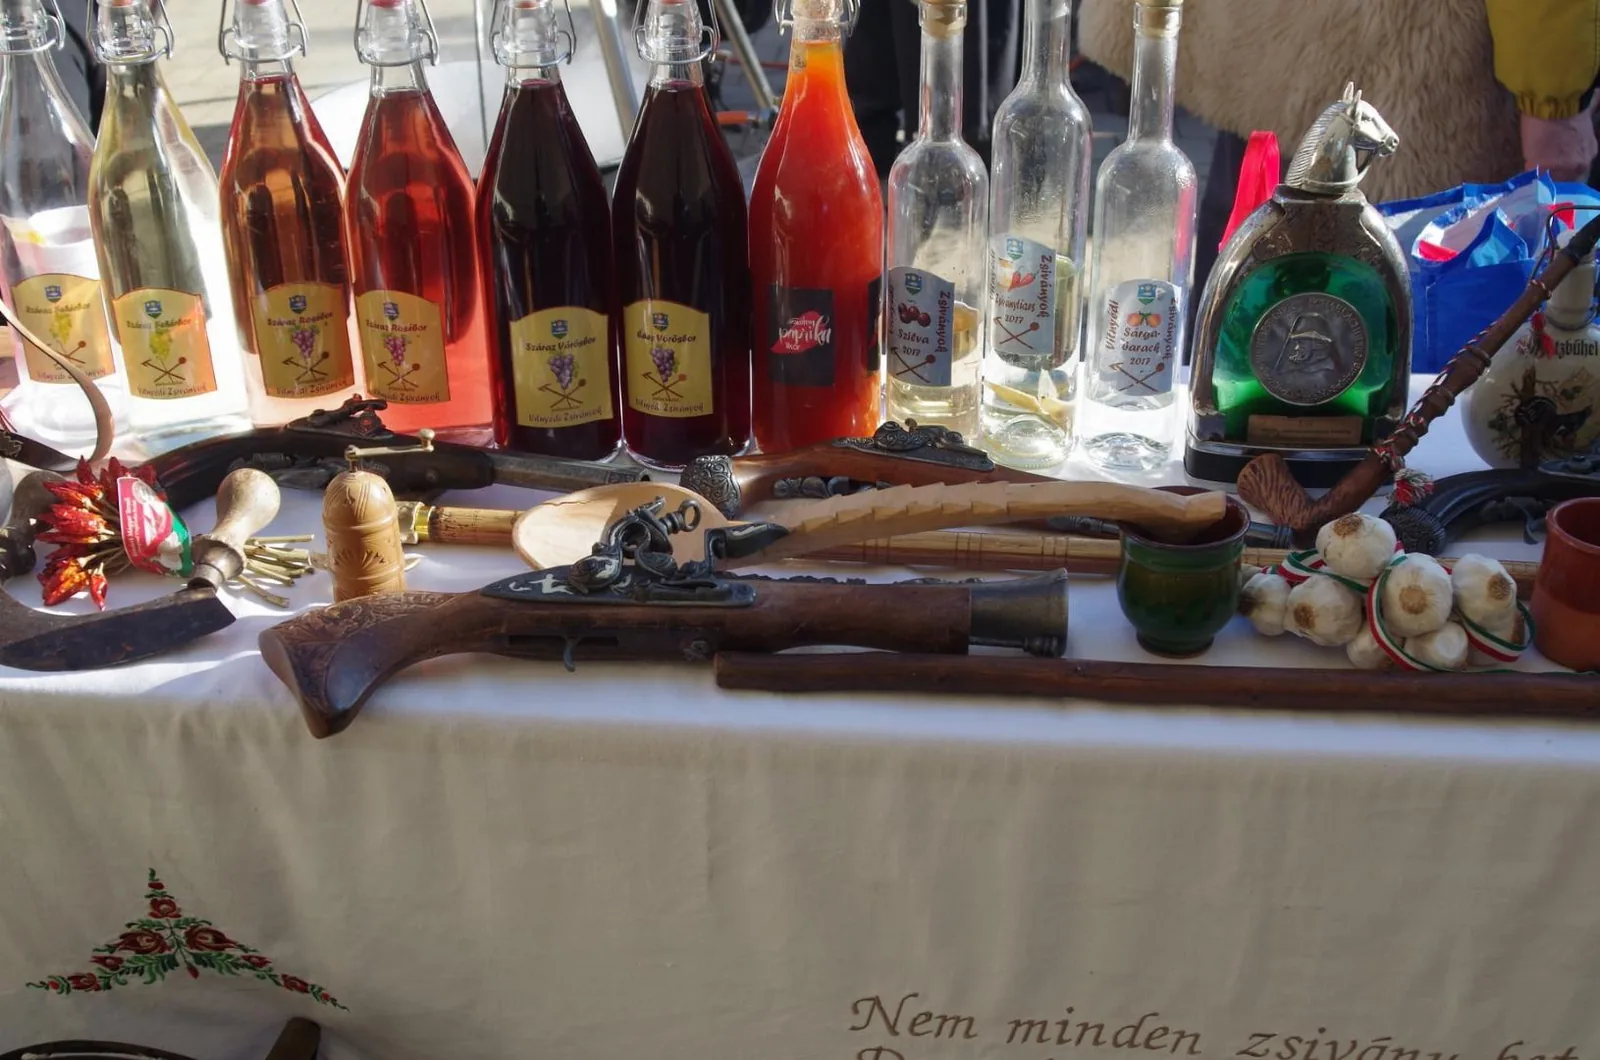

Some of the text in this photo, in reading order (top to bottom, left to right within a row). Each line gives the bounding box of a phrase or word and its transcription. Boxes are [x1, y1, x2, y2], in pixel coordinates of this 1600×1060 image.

[1005, 314, 1025, 324] 2017
[778, 315, 832, 346] paprika
[898, 329, 929, 344] Szilva
[525, 341, 556, 352] Száraz
[1129, 357, 1151, 366] 2017
[849, 992, 978, 1040] Nem
[1006, 1006, 1202, 1056] minden
[1235, 1026, 1460, 1060] zsiván
